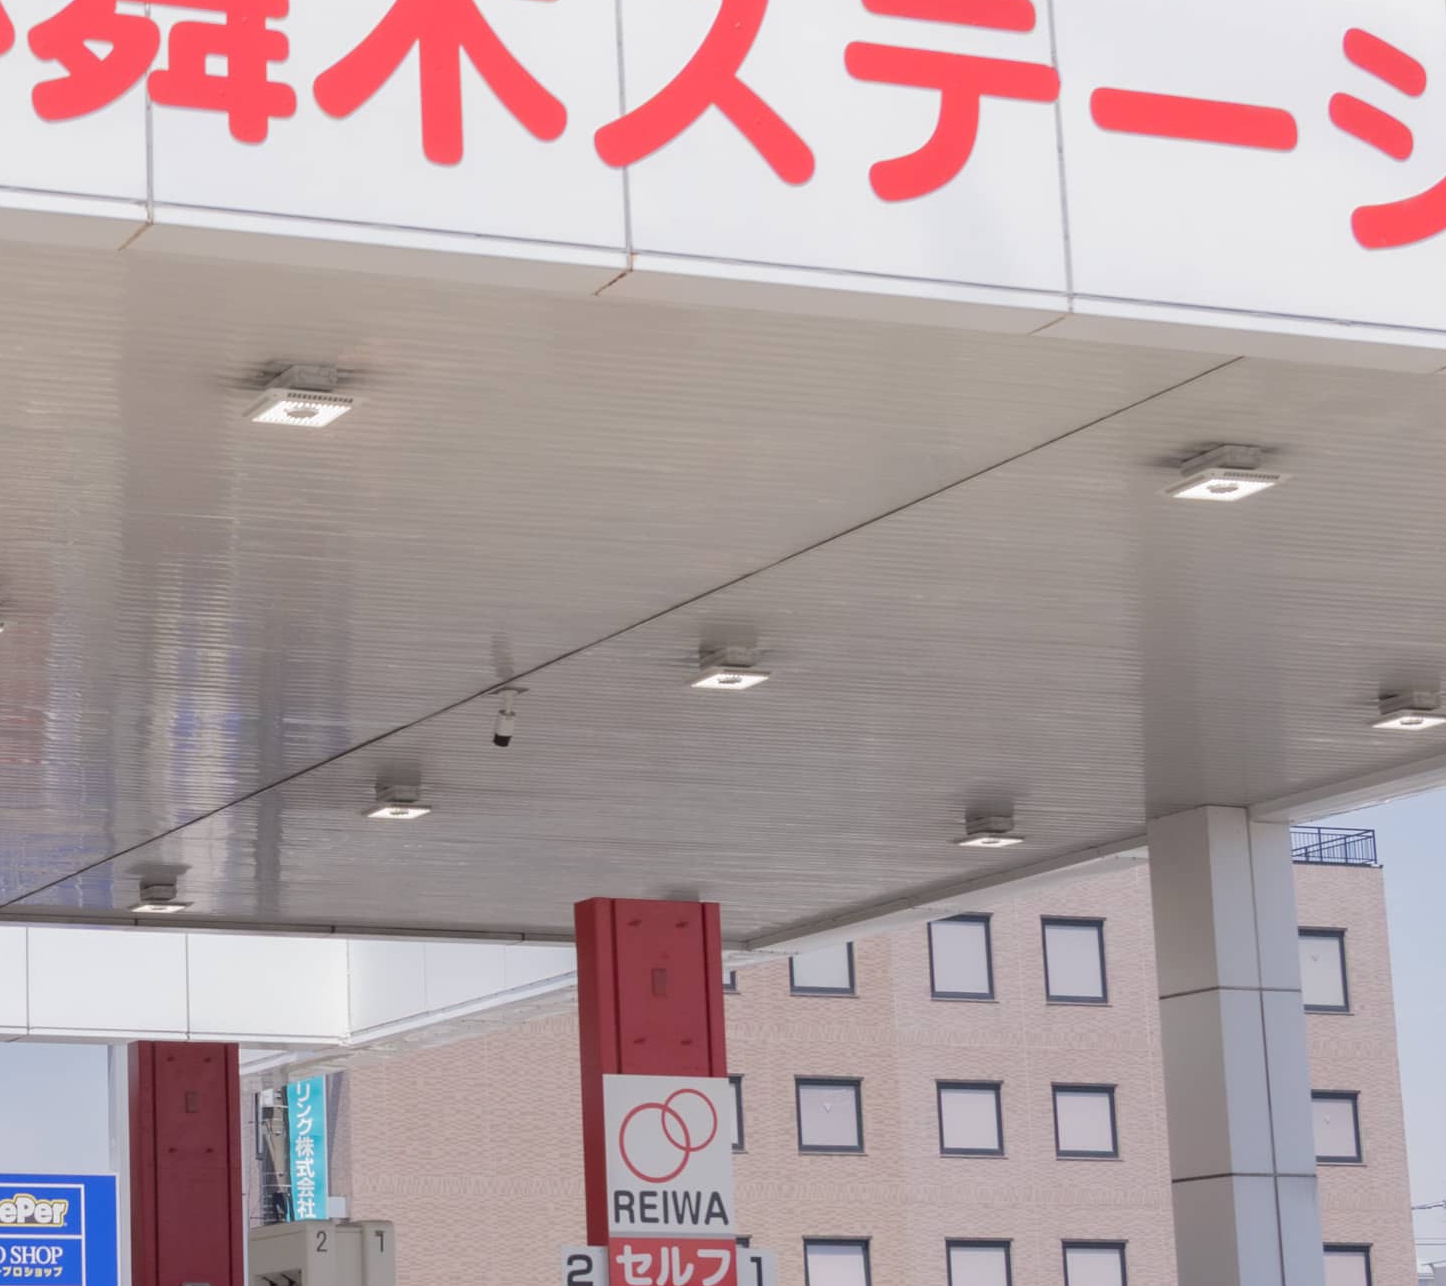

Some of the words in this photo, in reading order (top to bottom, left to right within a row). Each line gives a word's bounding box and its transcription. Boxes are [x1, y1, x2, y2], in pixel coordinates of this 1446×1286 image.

[614, 1190, 729, 1226] REIWA
[316, 1230, 328, 1253] 2
[9, 1244, 64, 1265] SHOP
